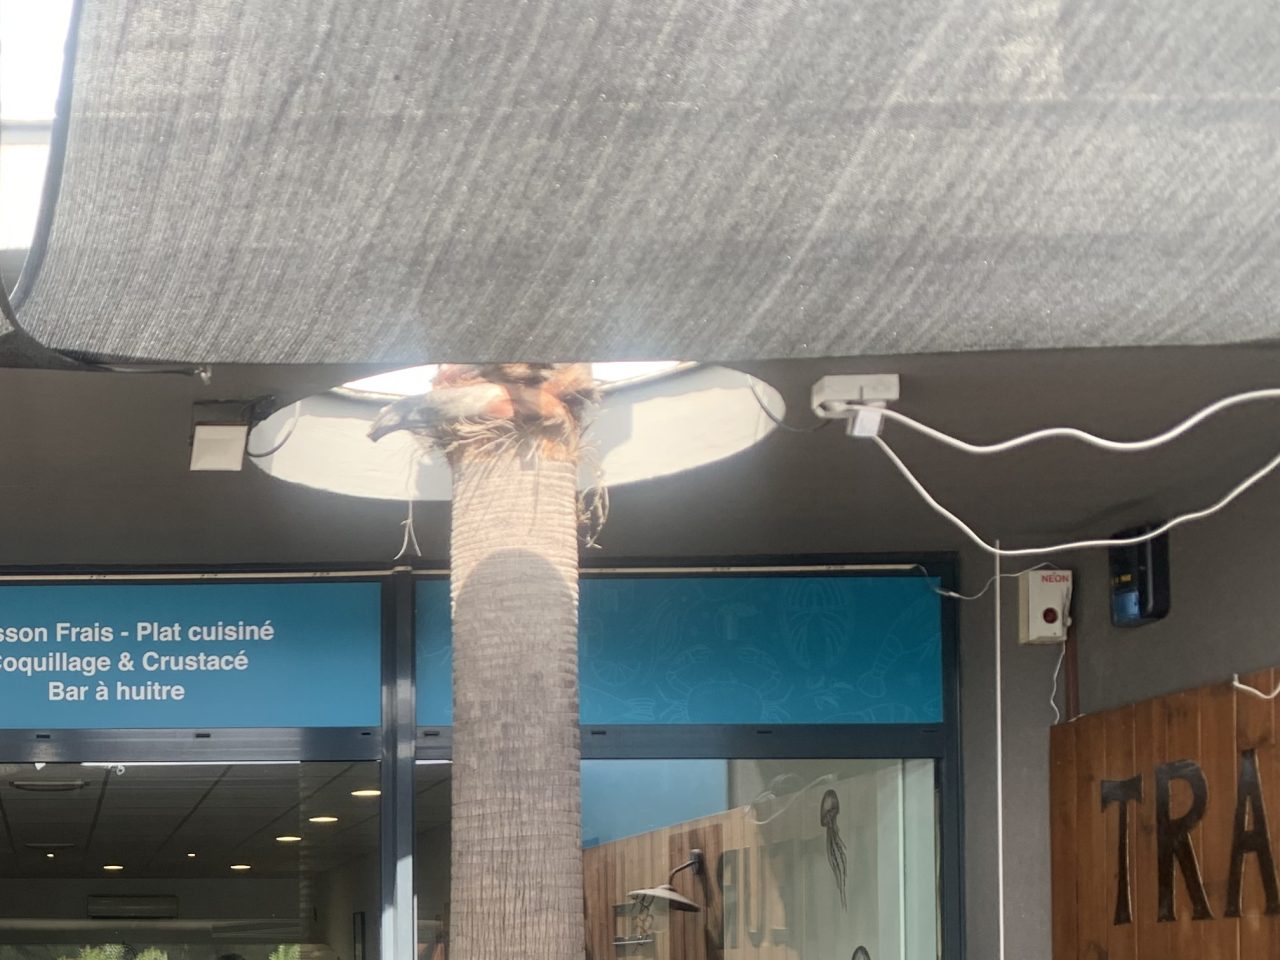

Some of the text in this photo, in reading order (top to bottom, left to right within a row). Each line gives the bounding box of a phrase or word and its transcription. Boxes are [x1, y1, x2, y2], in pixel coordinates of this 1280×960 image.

[1041, 574, 1069, 583] NEON
[56, 621, 114, 642] Frais
[136, 621, 182, 641] Plat
[187, 619, 275, 641] cuisiné
[118, 651, 135, 671] &
[142, 650, 249, 671] Crustacé
[48, 681, 185, 701] Bar à huitre
